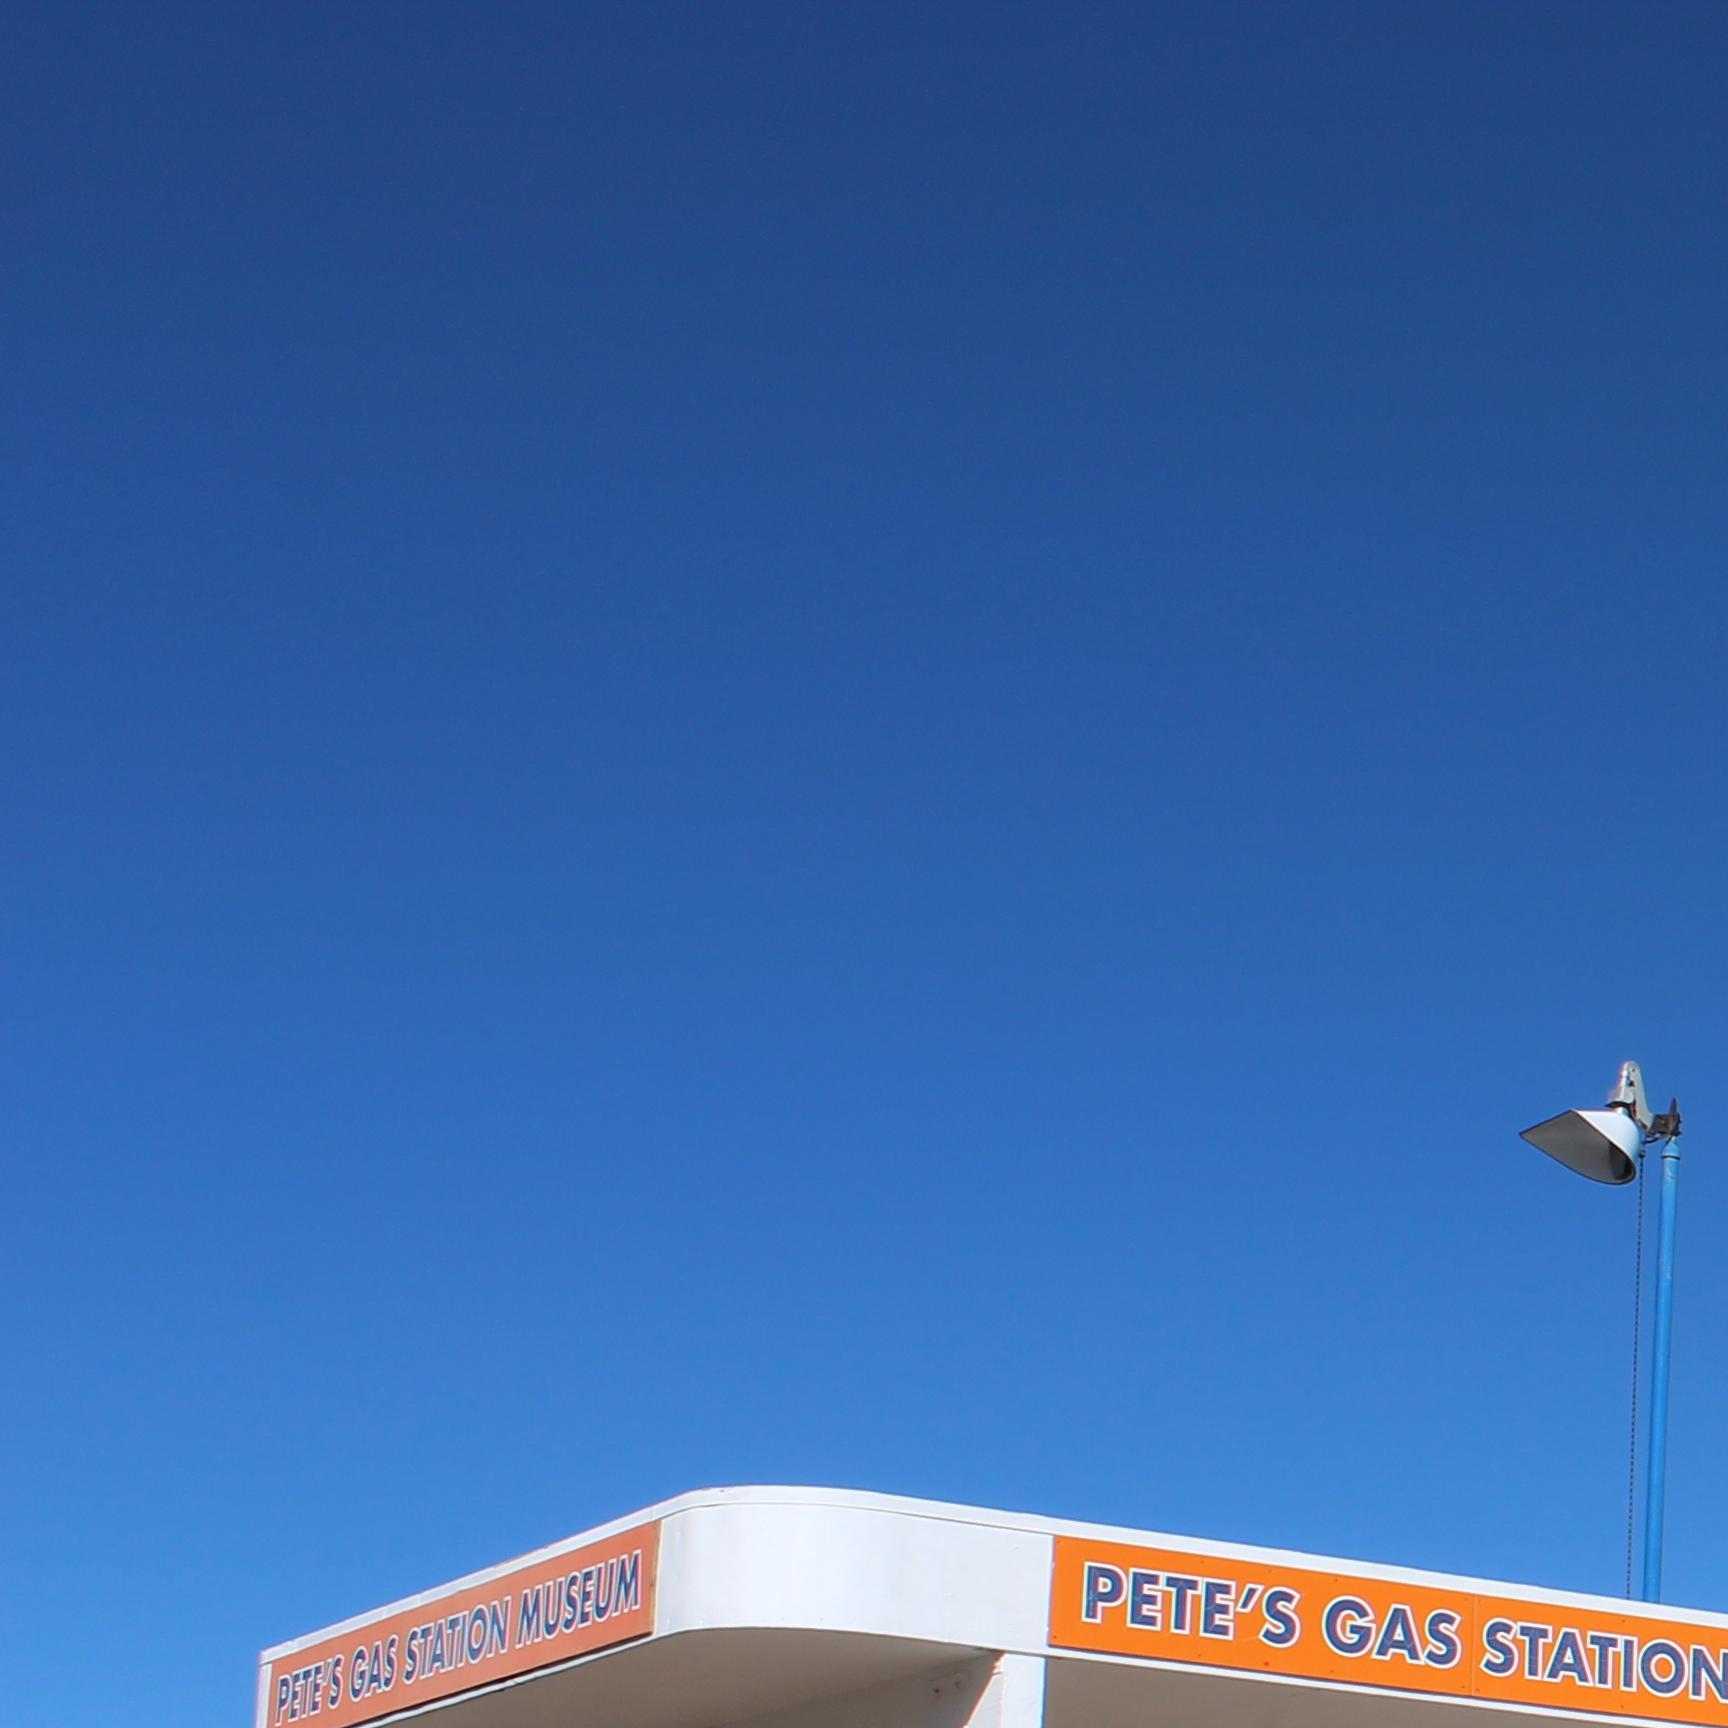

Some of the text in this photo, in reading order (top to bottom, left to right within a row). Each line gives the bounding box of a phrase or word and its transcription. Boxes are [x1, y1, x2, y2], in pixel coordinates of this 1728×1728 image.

[274, 1548, 643, 1727] PETE'S GAS STATION MUSEUM
[1080, 1561, 1302, 1649] PETE'S
[1321, 1594, 1463, 1671] GAS
